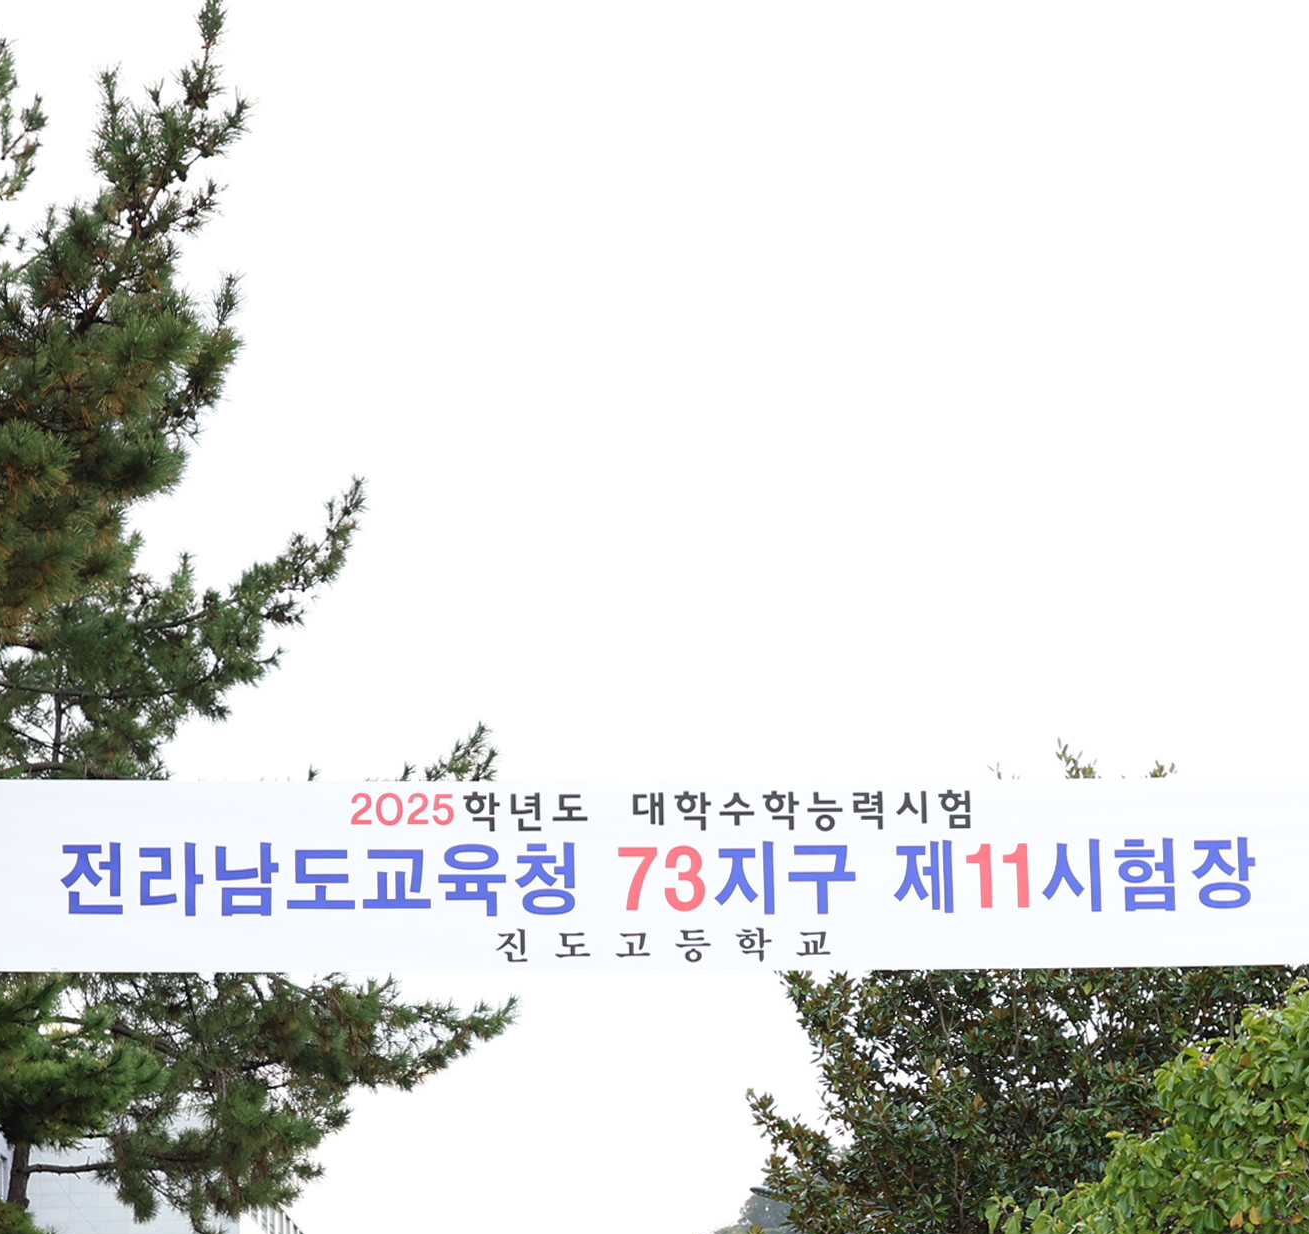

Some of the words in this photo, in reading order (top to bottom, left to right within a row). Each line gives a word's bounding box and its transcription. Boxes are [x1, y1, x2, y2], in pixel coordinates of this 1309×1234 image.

[350, 791, 589, 833] 2025학년도
[631, 789, 973, 831] 대학수학능력시험
[60, 840, 577, 917] 전라남도교육청
[616, 840, 857, 916] 73지구
[893, 835, 1256, 914] 제11시험장
